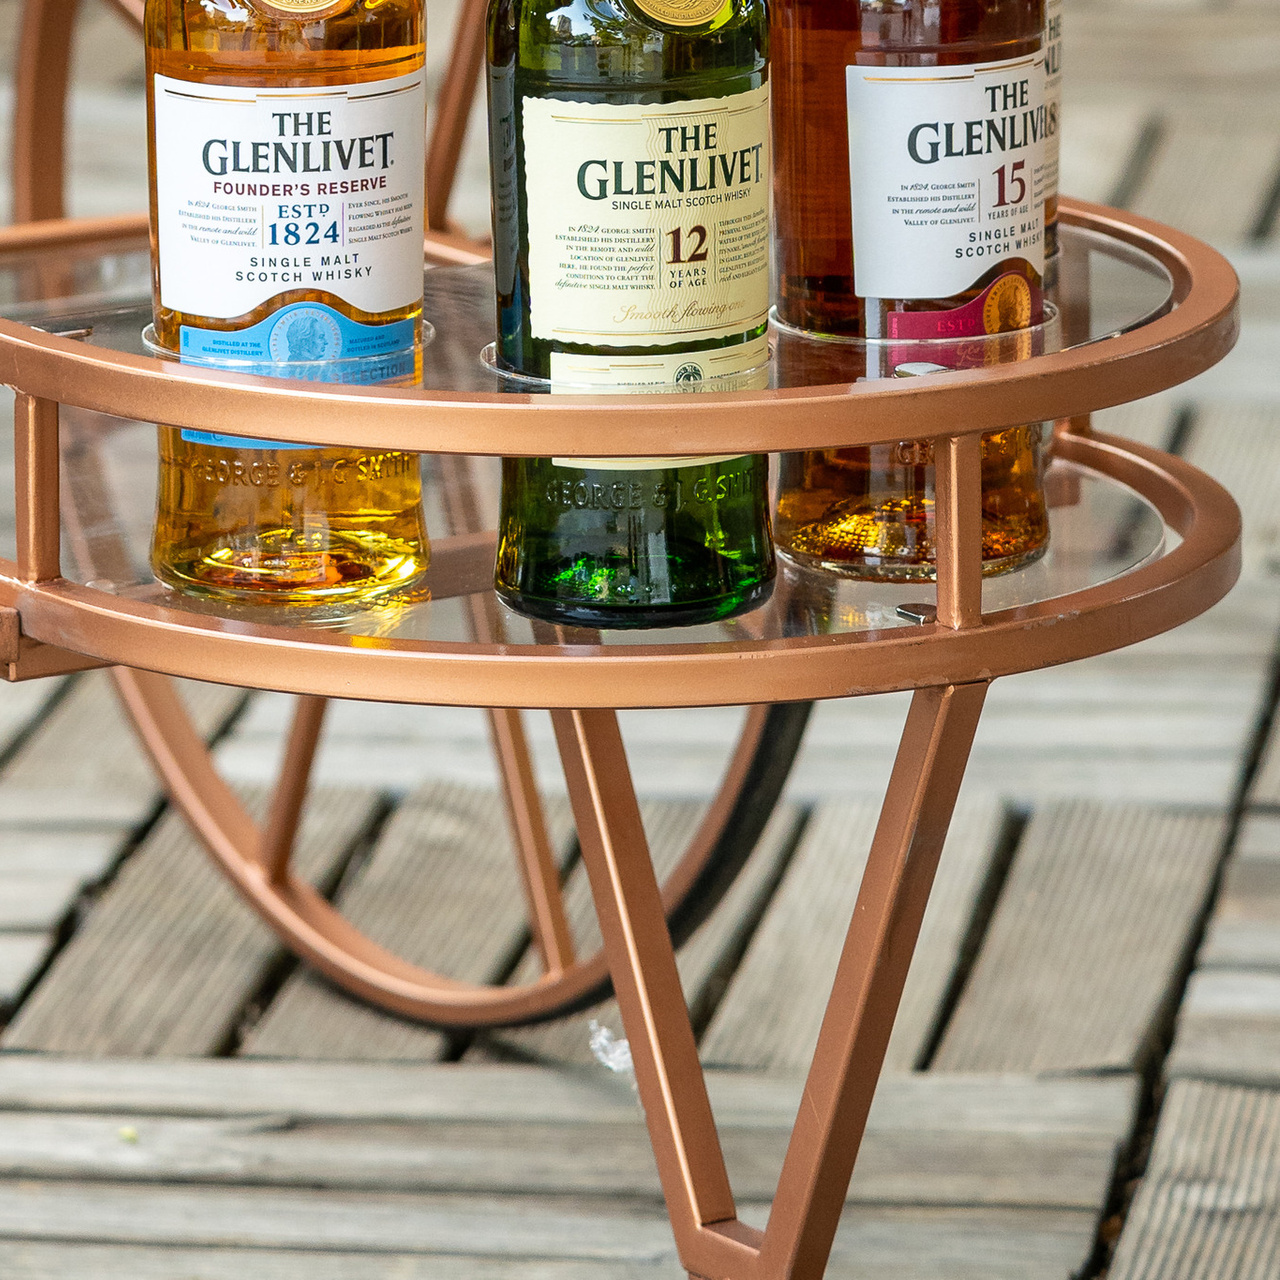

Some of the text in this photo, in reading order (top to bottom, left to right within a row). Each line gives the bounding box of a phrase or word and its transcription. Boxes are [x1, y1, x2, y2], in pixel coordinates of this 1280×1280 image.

[984, 79, 1029, 113] THE
[272, 111, 332, 136] THE
[659, 122, 717, 154] THE
[213, 176, 387, 196] FOUNDER'S RESERVE
[991, 159, 1026, 209] 15
[612, 189, 751, 211] SINGLE MALT SCOTCH WHISKY
[942, 204, 960, 214] and
[958, 202, 976, 212] wild
[988, 209, 1009, 220] YEARS
[1010, 207, 1018, 216] OF
[268, 221, 340, 246] 1824
[968, 218, 1040, 243] SINGLE MALT
[555, 235, 600, 243] ESTABLISHED
[665, 224, 708, 264] 12
[635, 244, 655, 252] wild
[955, 242, 1011, 259] SCOTCH
[250, 253, 359, 268] SINGLE MALT
[627, 263, 654, 274] perfect
[236, 266, 372, 282] SCOTCH WHISKY
[670, 267, 707, 278] YEARS
[670, 277, 707, 289] OF AGE
[613, 304, 679, 323] Smooth
[674, 301, 726, 323] flowing
[212, 339, 240, 347] DISTILLED
[231, 348, 263, 356] DISTILLERY
